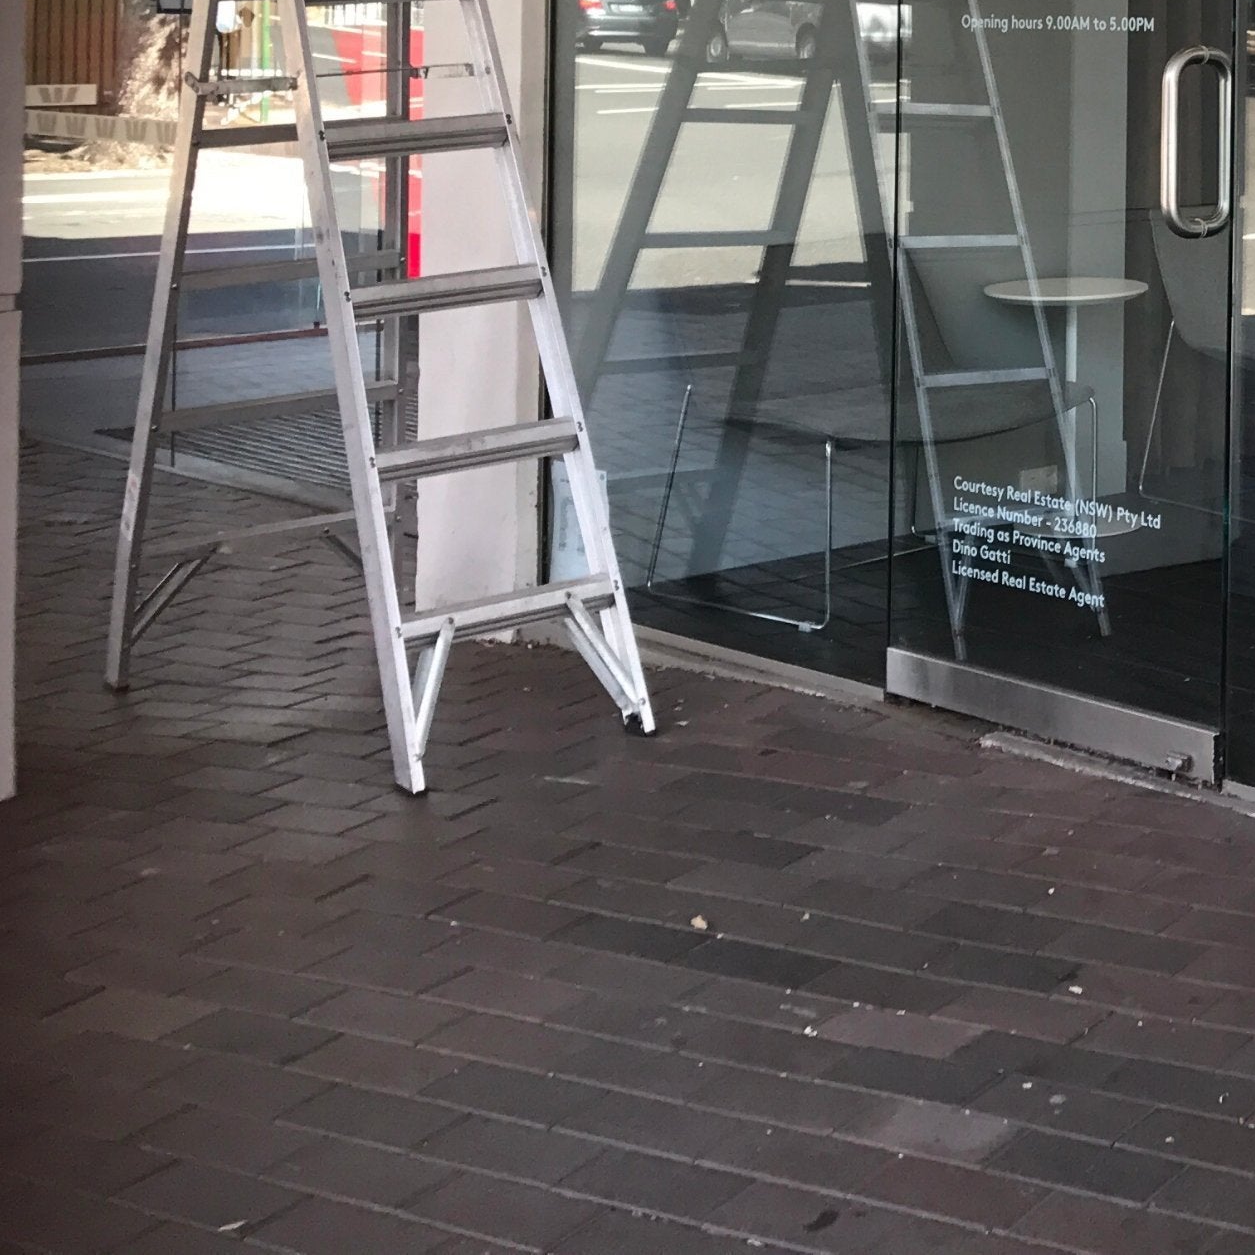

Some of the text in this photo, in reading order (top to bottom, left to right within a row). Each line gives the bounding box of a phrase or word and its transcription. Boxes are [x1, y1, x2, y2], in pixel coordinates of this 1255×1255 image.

[961, 14, 1155, 33] Opening hours 9.00AM to 5.00PM
[953, 475, 1161, 530] Courtesy Real Estate (NSW) Pty Ltd
[953, 497, 995, 519] Licence
[997, 505, 1043, 529] Number
[952, 518, 1106, 563] Trading as Province Agents
[952, 539, 1011, 565] Dino Gatti
[952, 560, 1105, 609] Licensed Real Estate Agent
